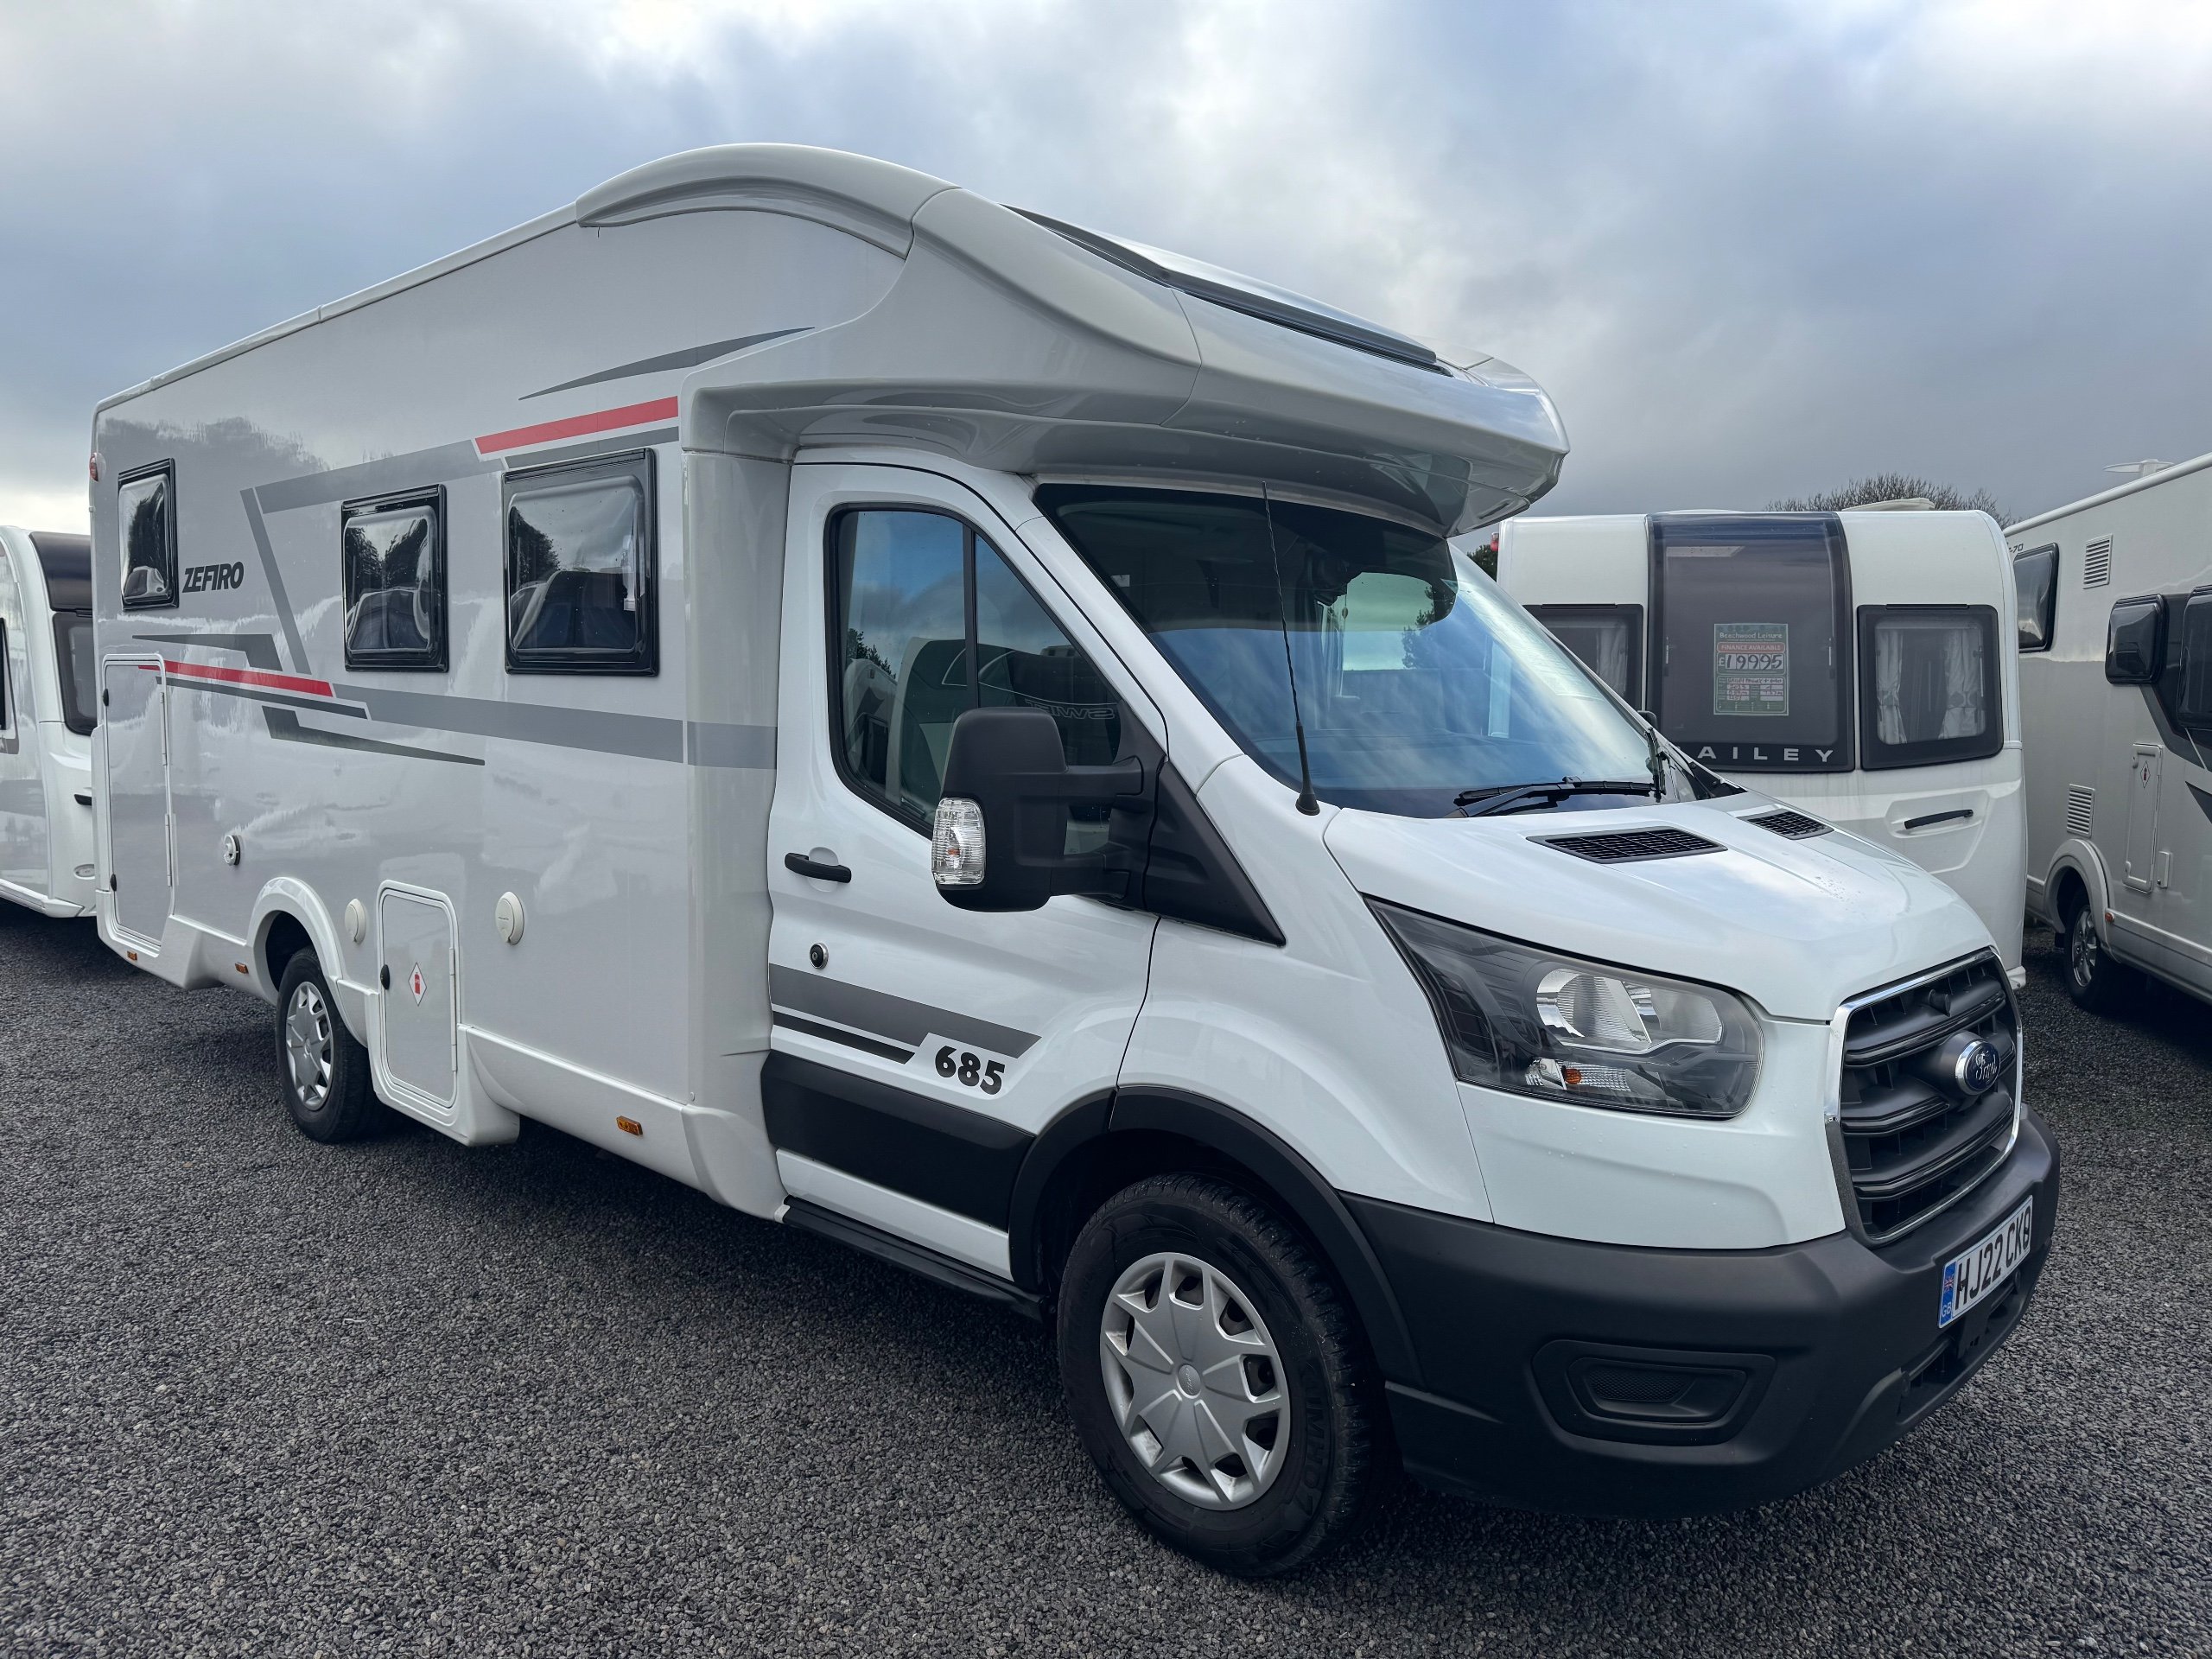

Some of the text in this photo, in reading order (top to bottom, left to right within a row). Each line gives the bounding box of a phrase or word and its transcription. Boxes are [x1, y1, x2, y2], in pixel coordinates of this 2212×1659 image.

[182, 561, 245, 594] ZEFIRO
[1677, 746, 1834, 763] AILEY
[935, 1045, 1006, 1096] 685
[1975, 1051, 1998, 1081] Ford
[1955, 1233, 2004, 1311] HJ22
[1941, 1301, 1953, 1318] GB
